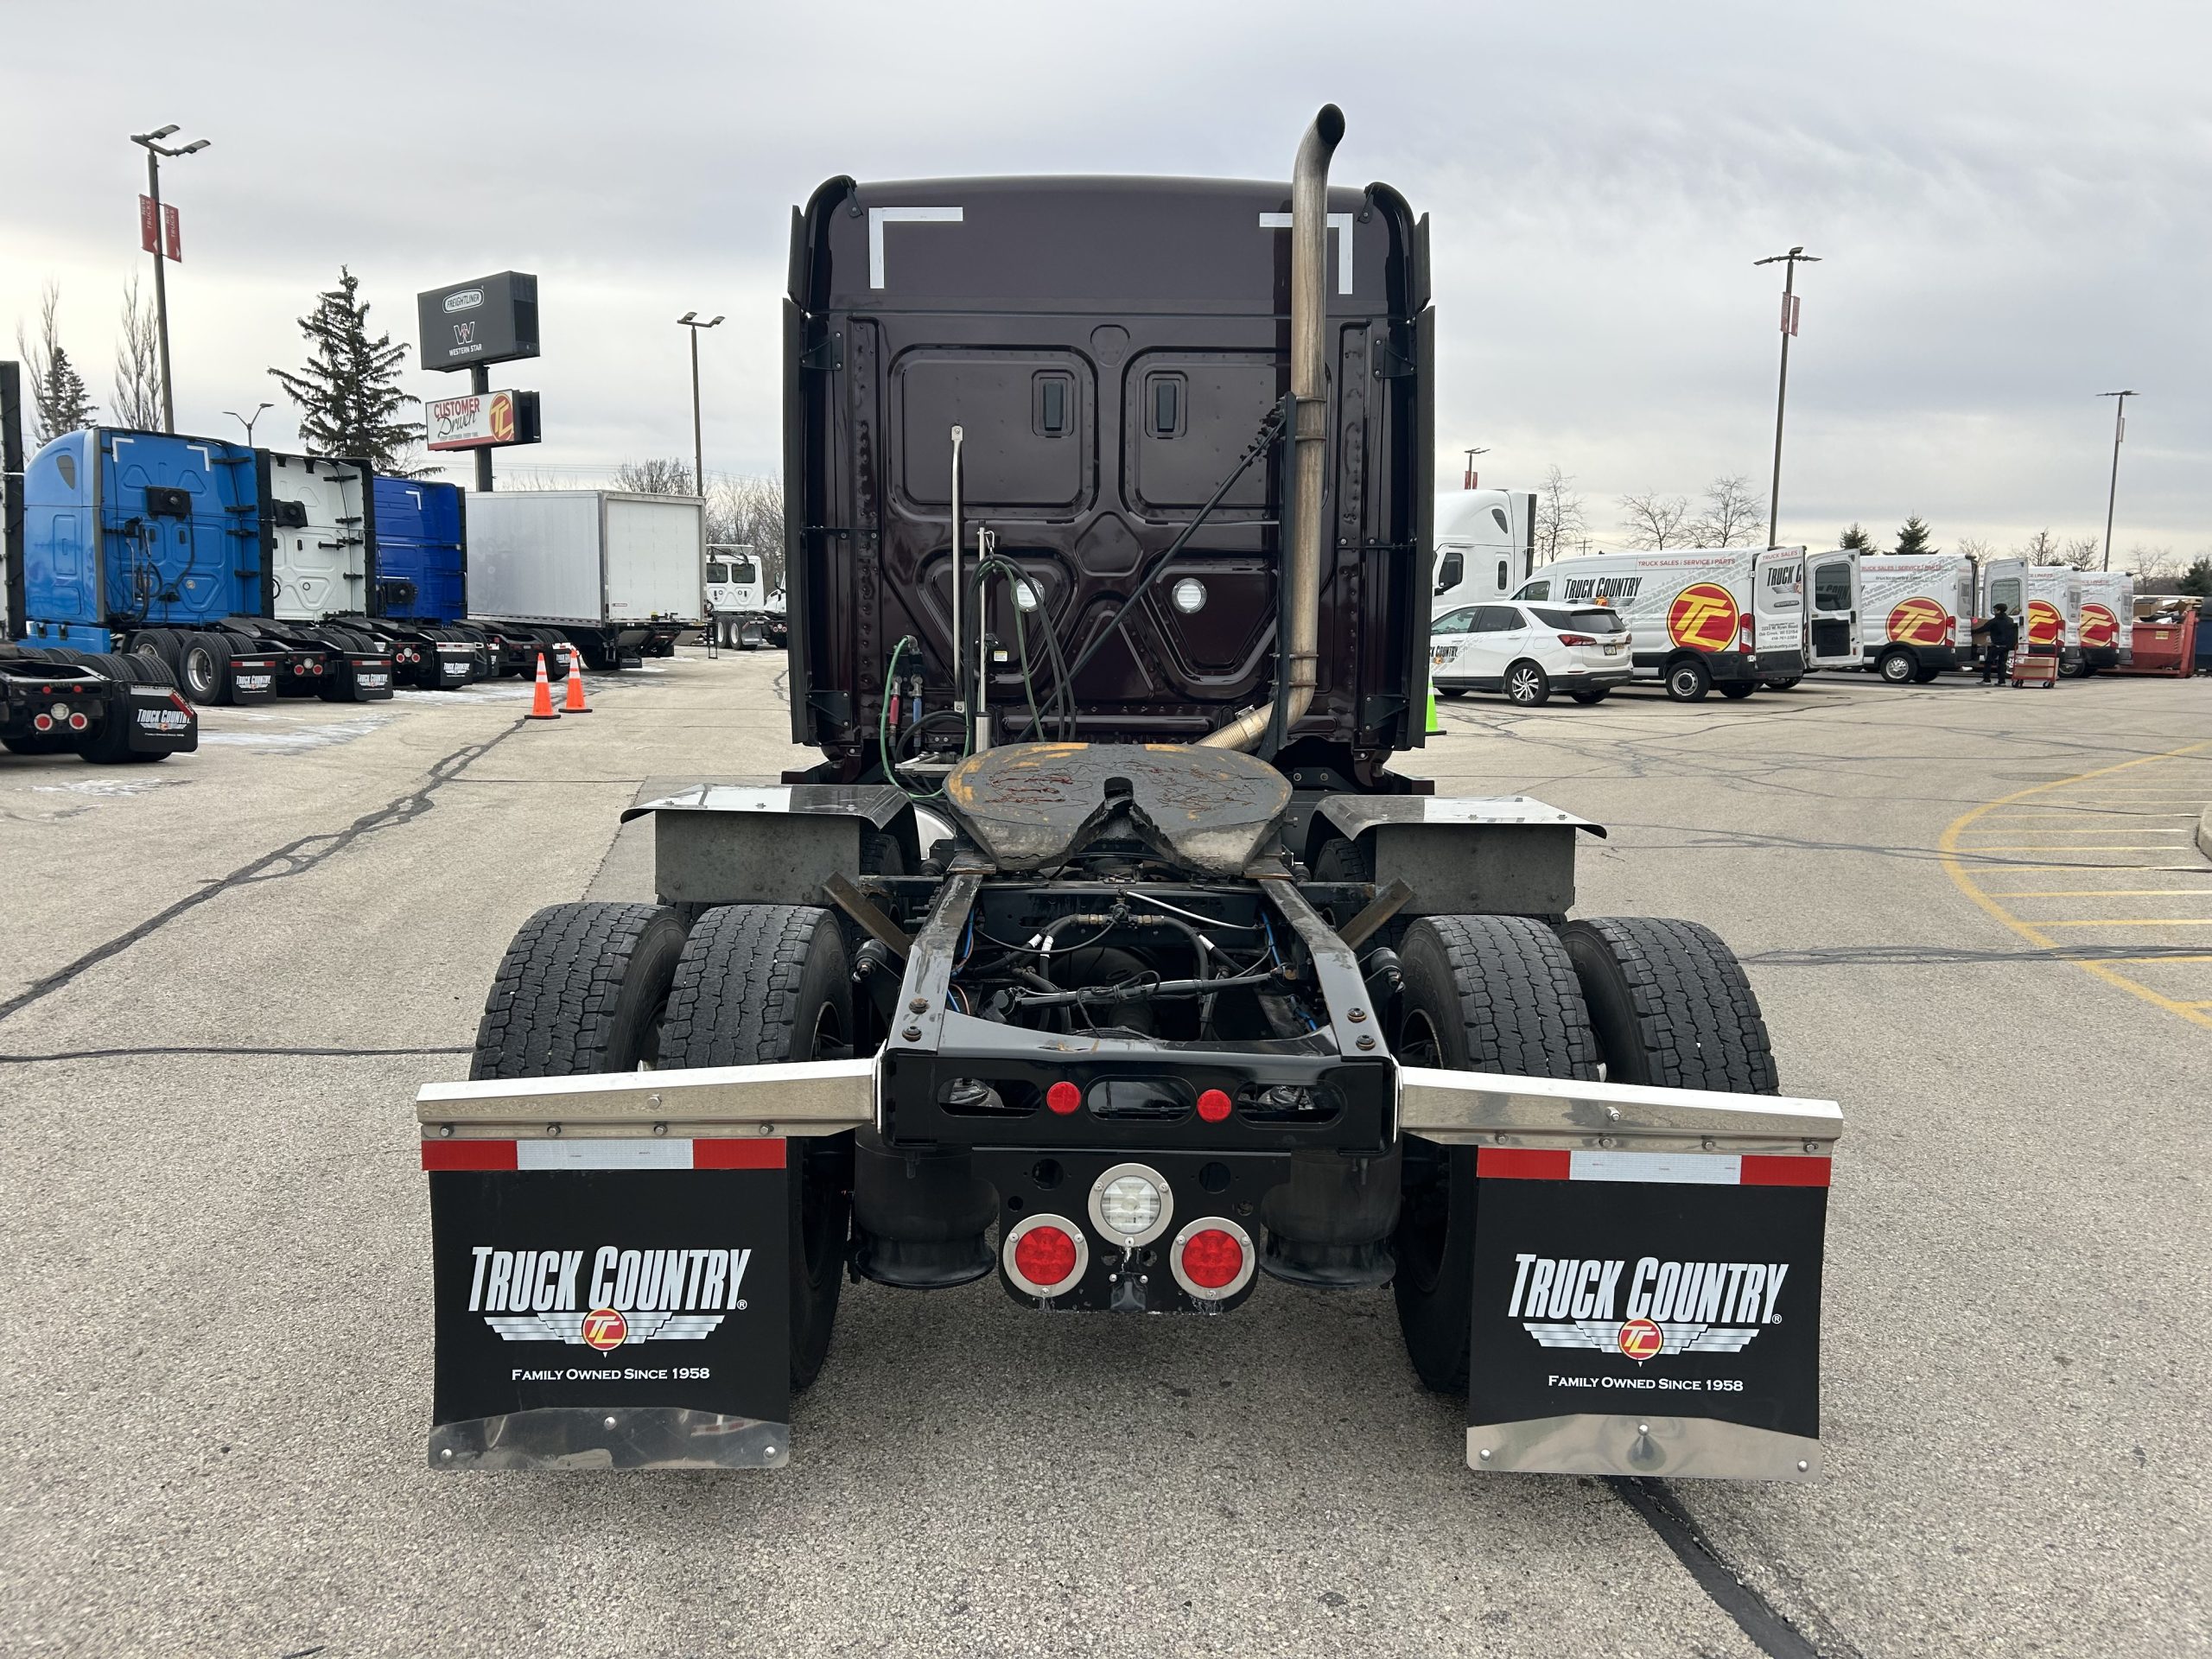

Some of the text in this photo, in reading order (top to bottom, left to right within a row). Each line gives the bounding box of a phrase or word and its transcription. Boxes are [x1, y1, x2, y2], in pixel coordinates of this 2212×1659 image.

[447, 293, 480, 308] FREIGHTLINER
[449, 343, 482, 356] WESTERN STAR
[434, 397, 480, 418] CUSTOMER
[437, 410, 476, 438] Driven
[1767, 565, 1795, 587] TRUCK
[1564, 577, 1643, 599] TRUCK COUNTRY
[137, 709, 162, 722] TRUCK
[468, 1245, 752, 1312] TRUCK COUNTRY
[1508, 1253, 1789, 1324] TRUCK COUNTRY
[512, 1367, 710, 1381] FAMILY OWNED SINCE 1958
[1548, 1375, 1744, 1392] FAMILY OWNED SINCE 1958
